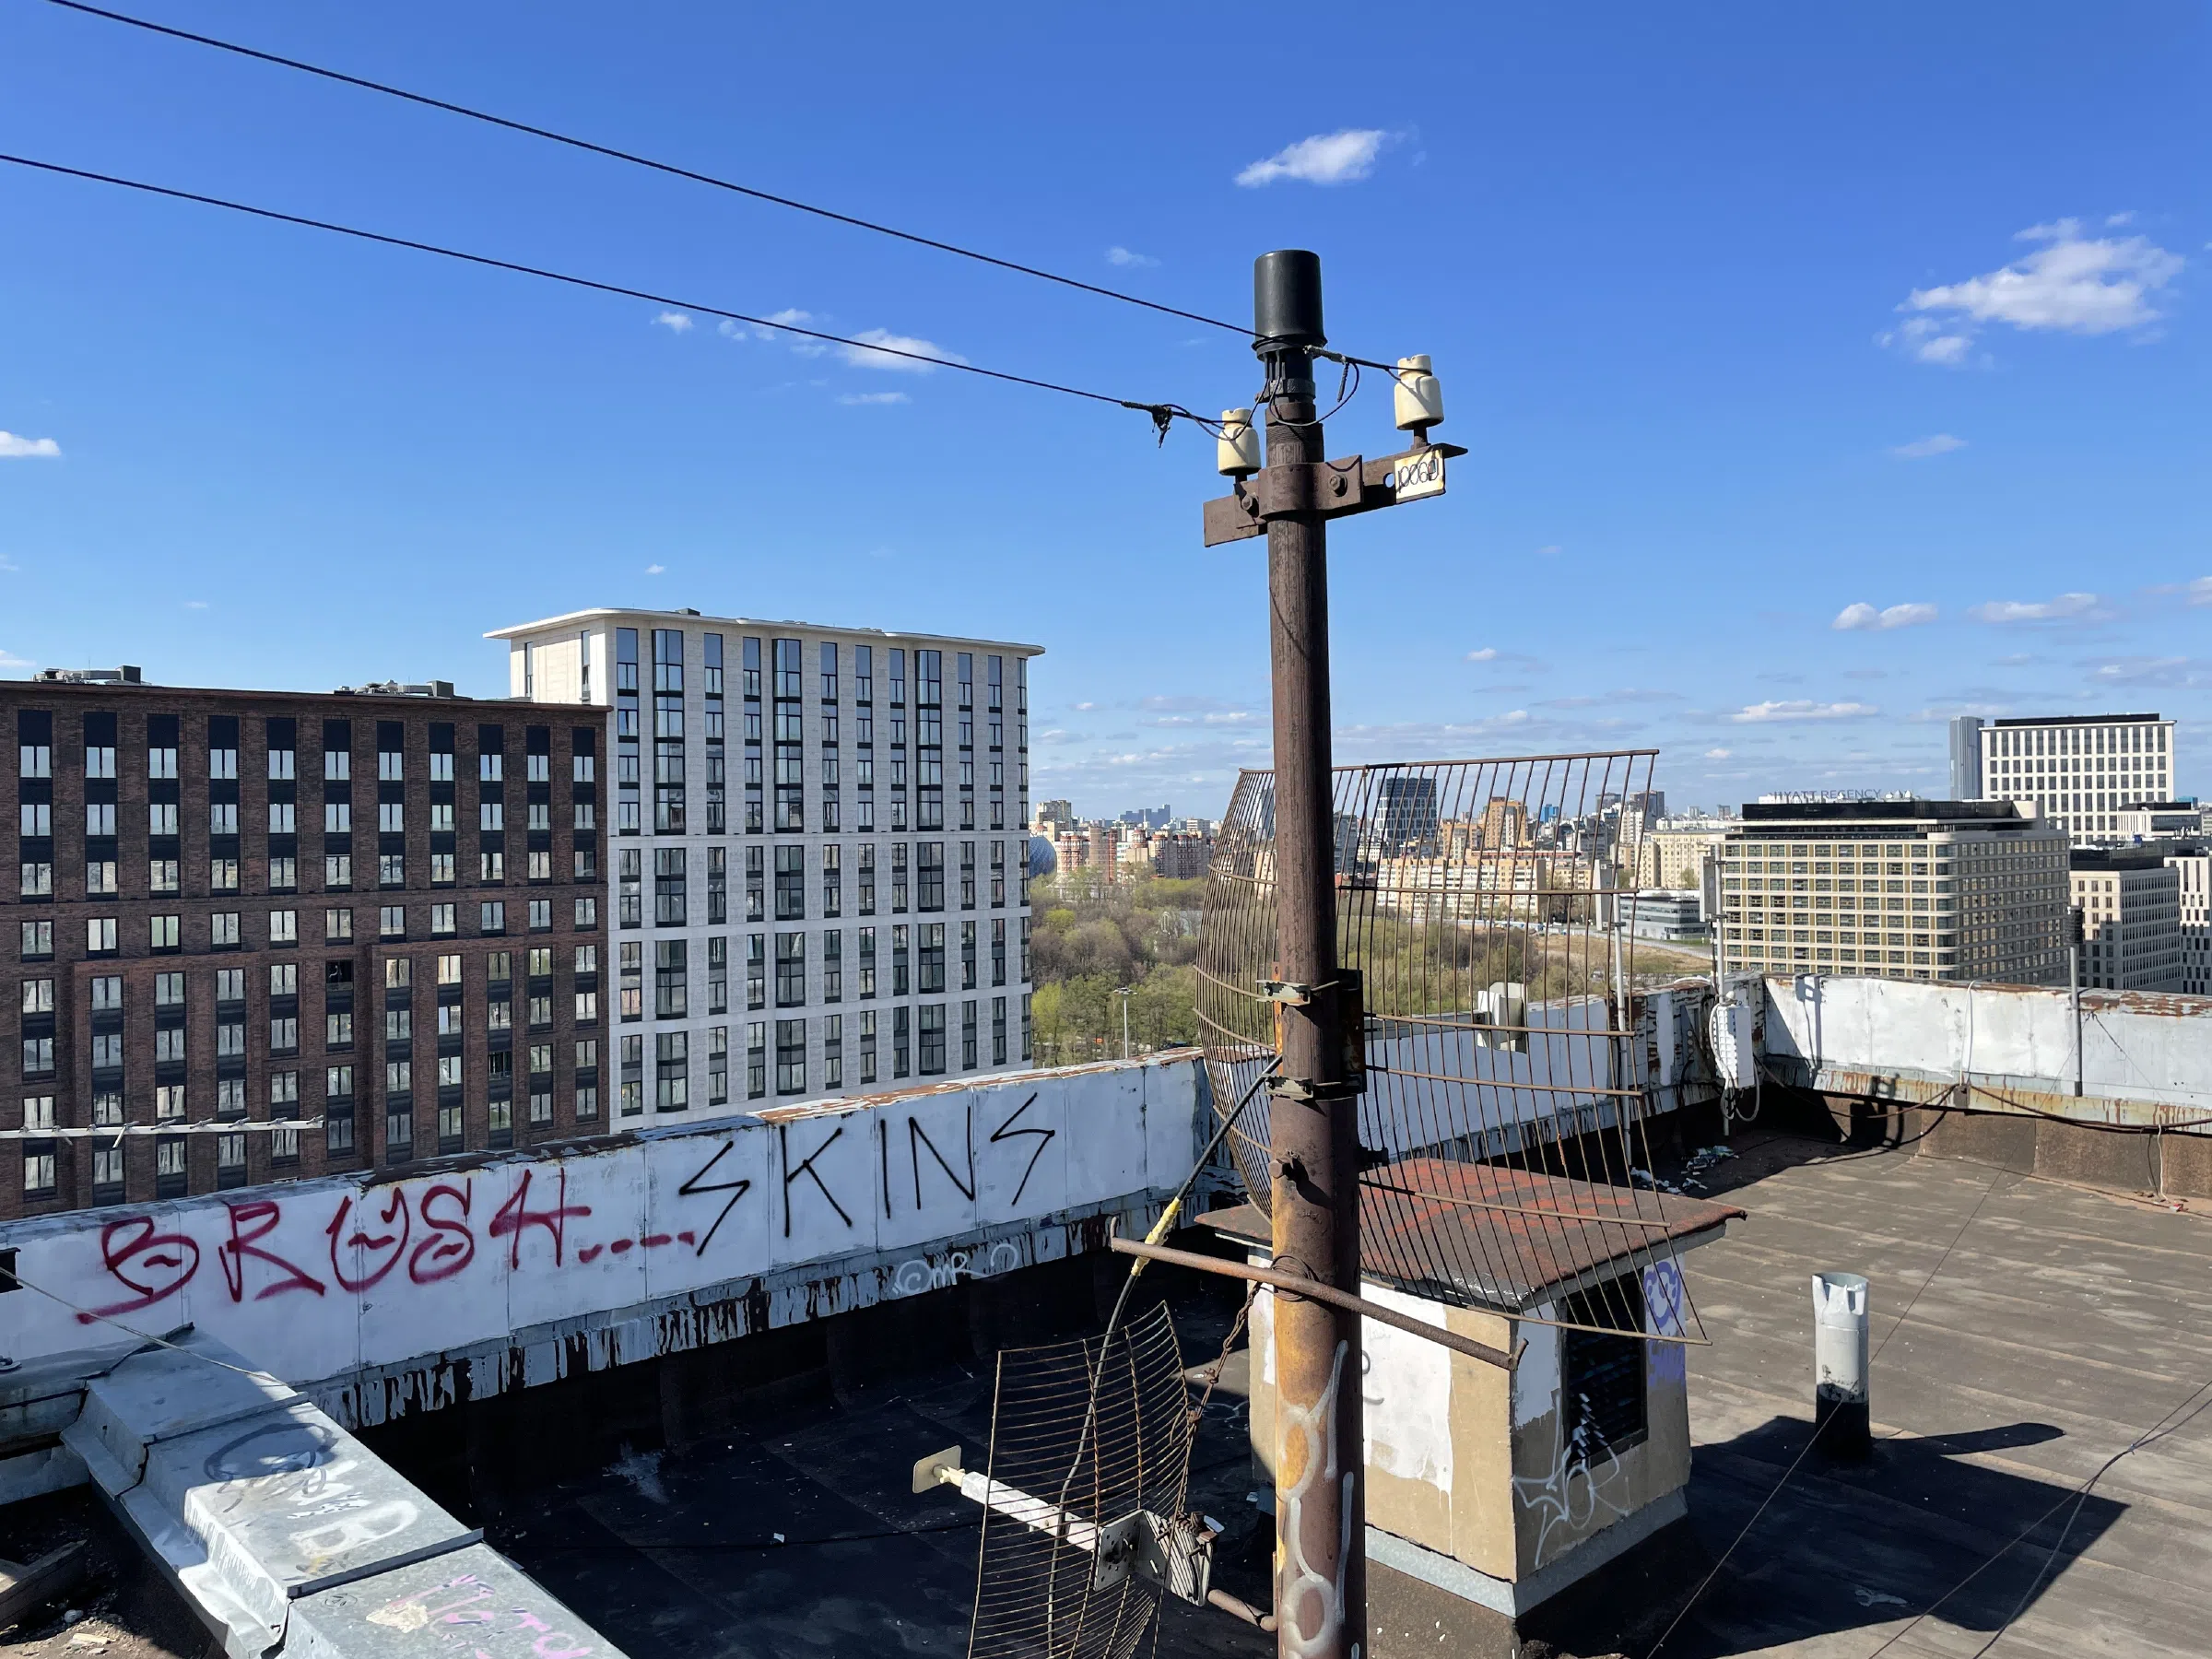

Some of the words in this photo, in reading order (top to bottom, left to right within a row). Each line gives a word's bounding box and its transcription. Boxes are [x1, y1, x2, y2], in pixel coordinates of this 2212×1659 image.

[1774, 790, 1818, 802] HYATT
[1820, 788, 1882, 800] REGENCY
[678, 1092, 1055, 1256] SKINS
